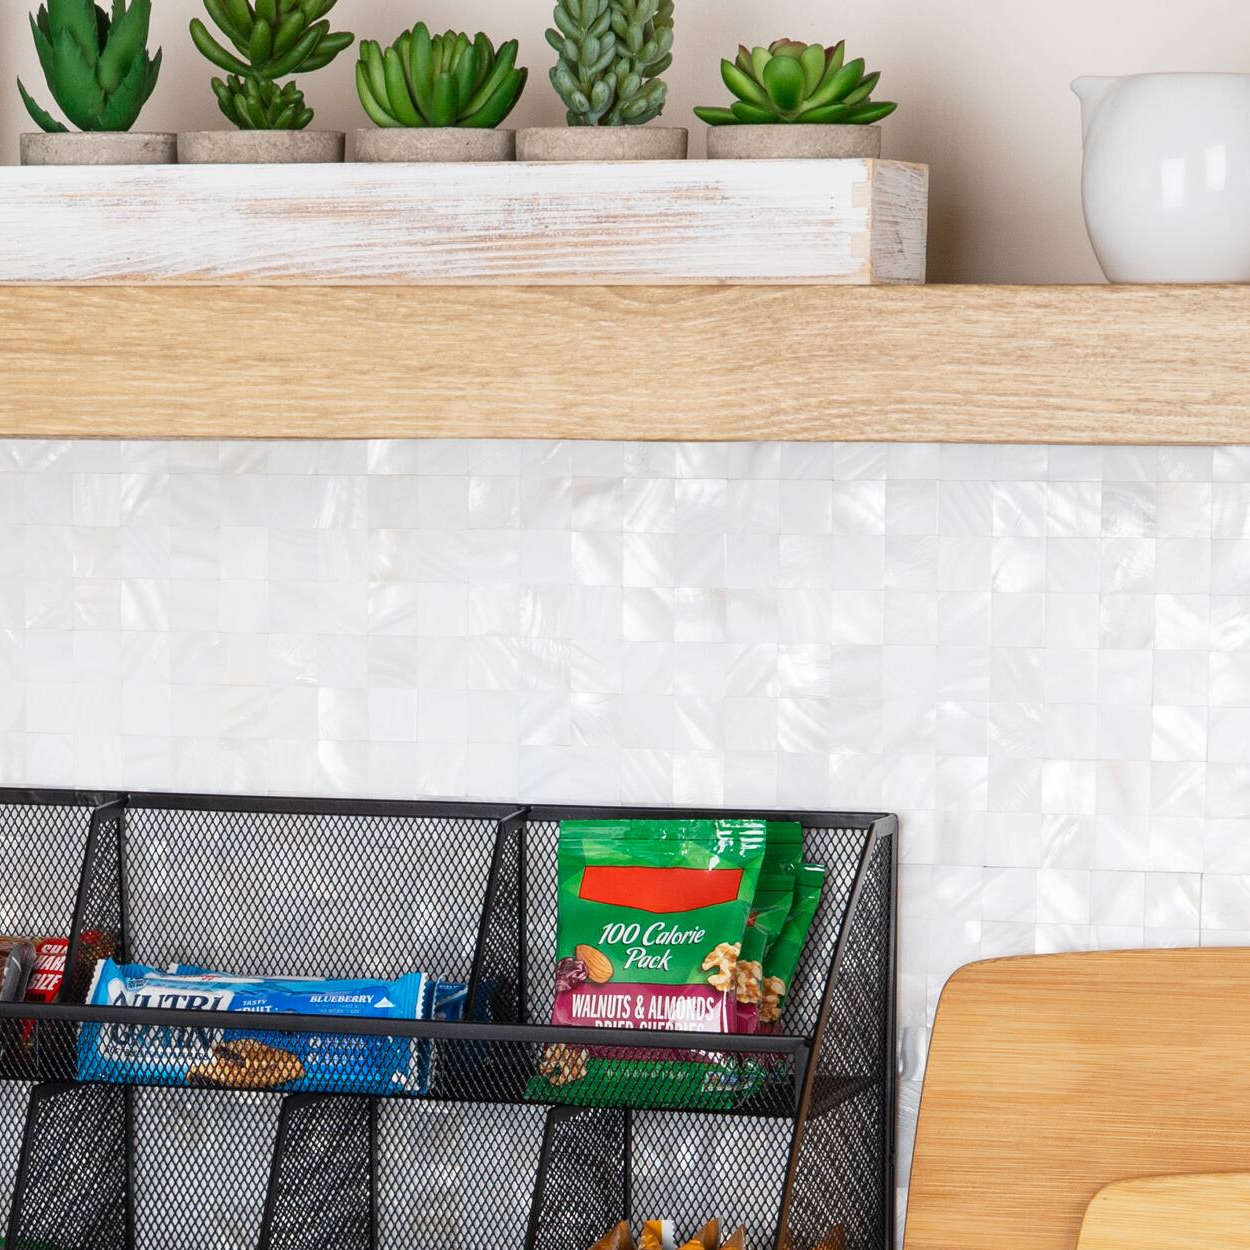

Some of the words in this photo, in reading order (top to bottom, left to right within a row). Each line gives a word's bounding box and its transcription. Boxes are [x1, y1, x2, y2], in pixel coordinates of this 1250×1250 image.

[598, 922, 641, 946] 100
[642, 922, 706, 946] Calorie
[623, 946, 673, 971] Pack
[27, 973, 63, 991] SIZE
[310, 994, 375, 1004] BLUEBERRY
[572, 994, 631, 1019] WALNUTS
[634, 995, 645, 1019] &
[649, 995, 716, 1021] ALMONDS
